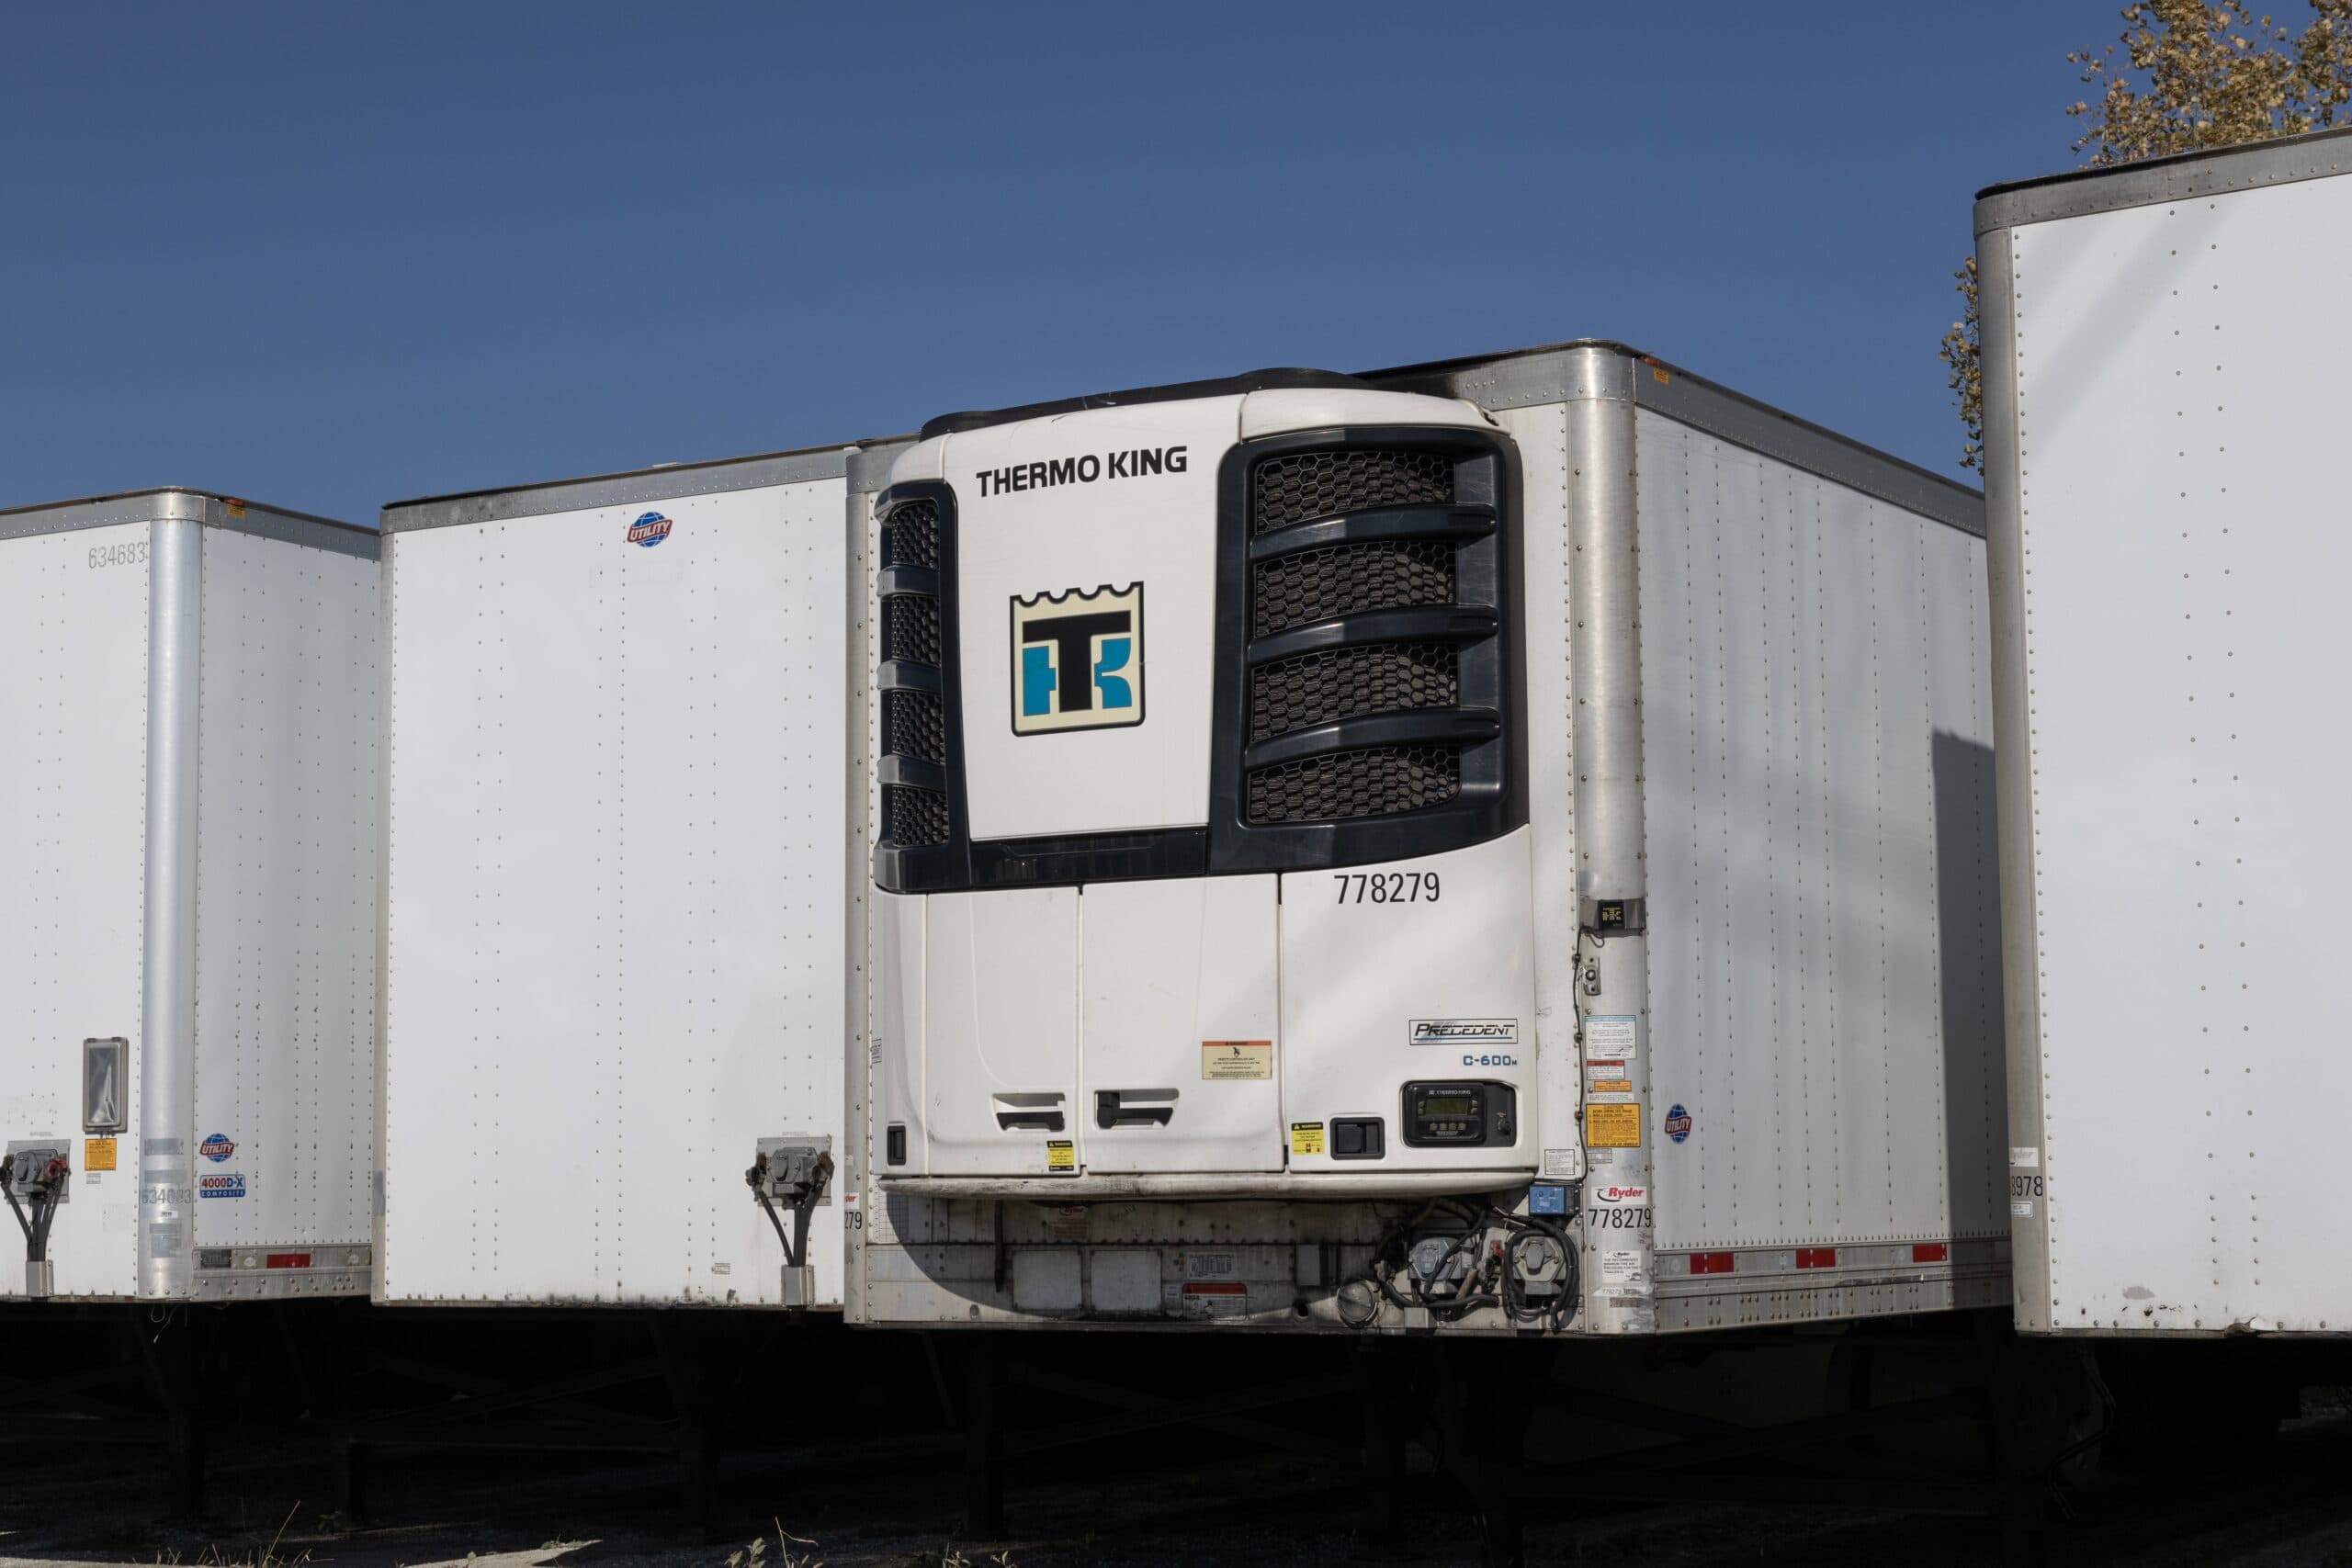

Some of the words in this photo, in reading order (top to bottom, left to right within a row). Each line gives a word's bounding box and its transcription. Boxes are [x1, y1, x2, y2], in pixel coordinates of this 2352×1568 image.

[976, 455, 1101, 497] THERMO
[1108, 446, 1187, 479] KING
[629, 521, 671, 541] UTILITY
[89, 541, 145, 569] 634683
[1334, 872, 1440, 904] 778279
[1415, 1023, 1515, 1036] PRECEDENT
[1667, 1117, 1690, 1133] UTILITY
[202, 1143, 232, 1154] UTILITY
[202, 1177, 243, 1189] 4000D-X
[1609, 1187, 1644, 1200] Ryder
[1588, 1208, 1652, 1229] 778279
